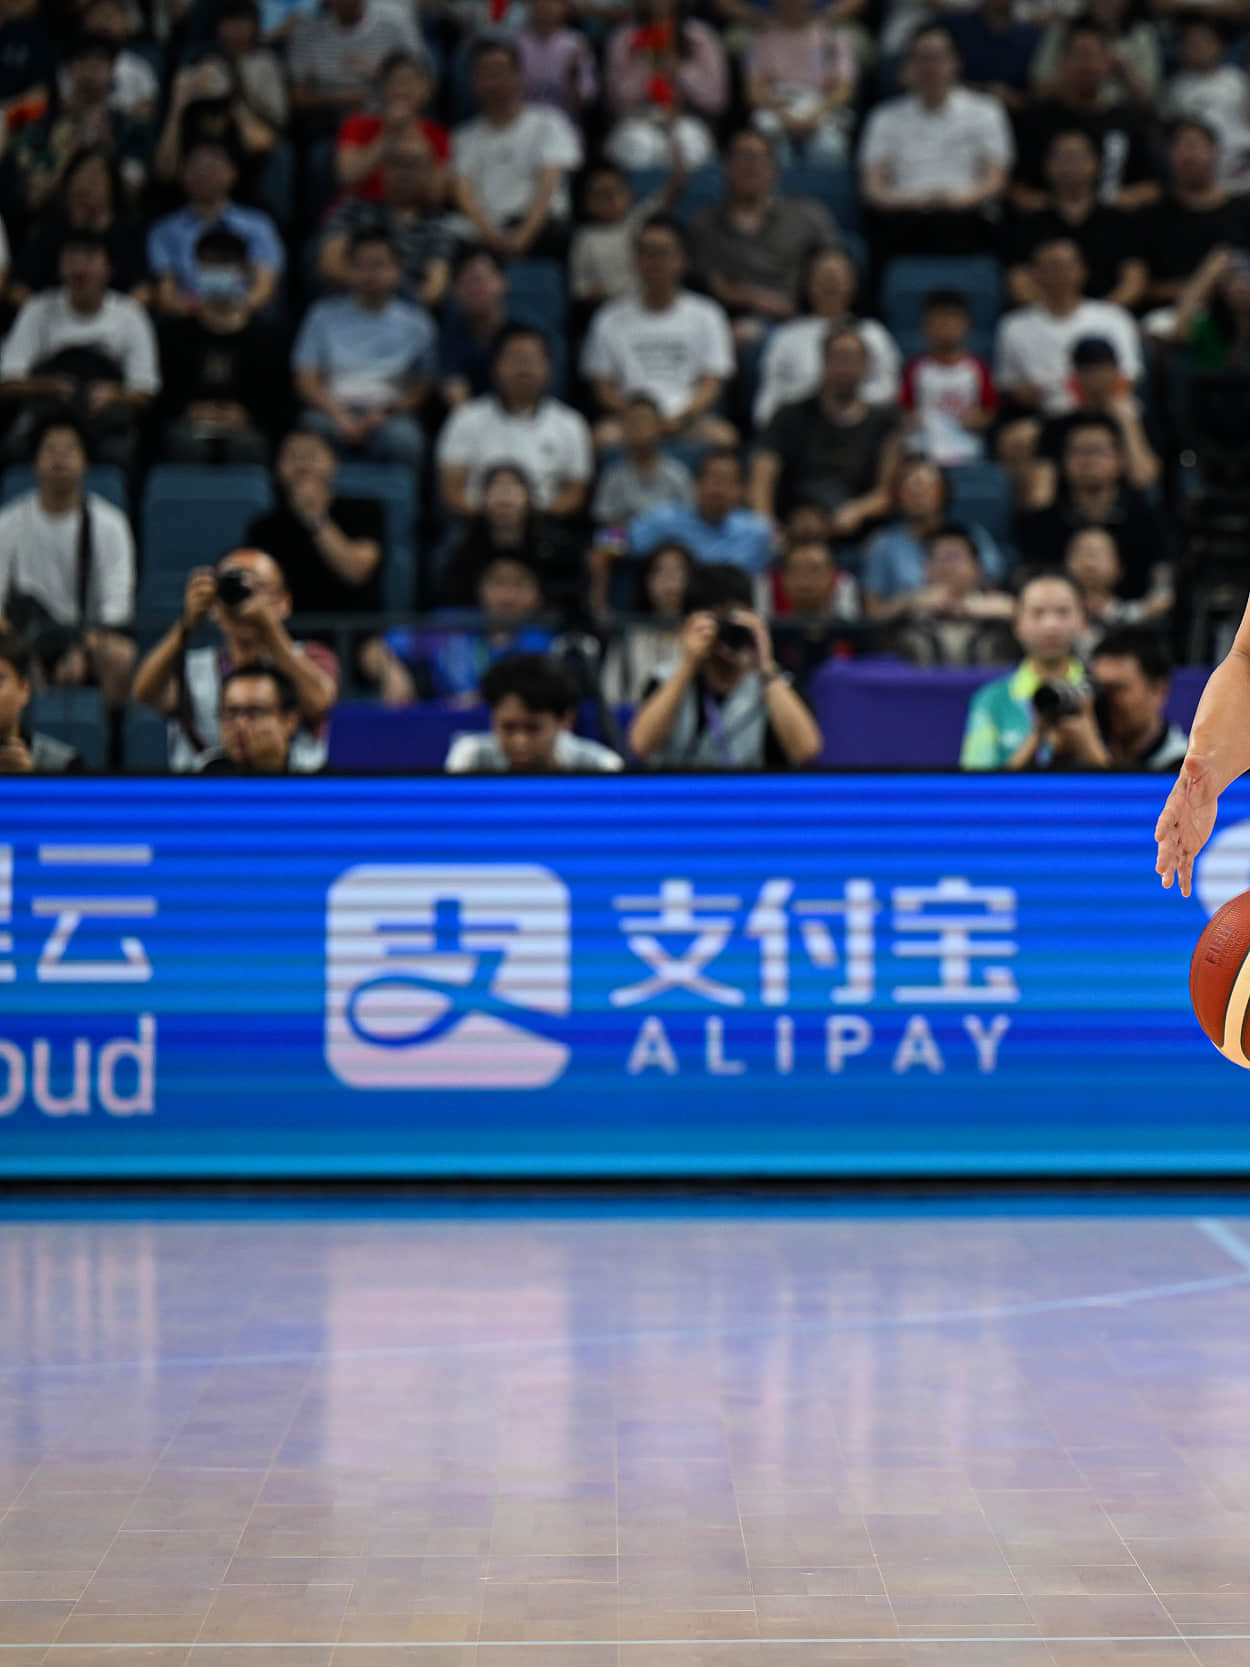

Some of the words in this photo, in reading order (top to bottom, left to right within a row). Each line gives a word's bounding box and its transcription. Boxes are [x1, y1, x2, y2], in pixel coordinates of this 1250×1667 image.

[0, 843, 157, 983] 云
[609, 877, 1022, 1006] 支付宝
[626, 1015, 1011, 1075] ALIPAY
